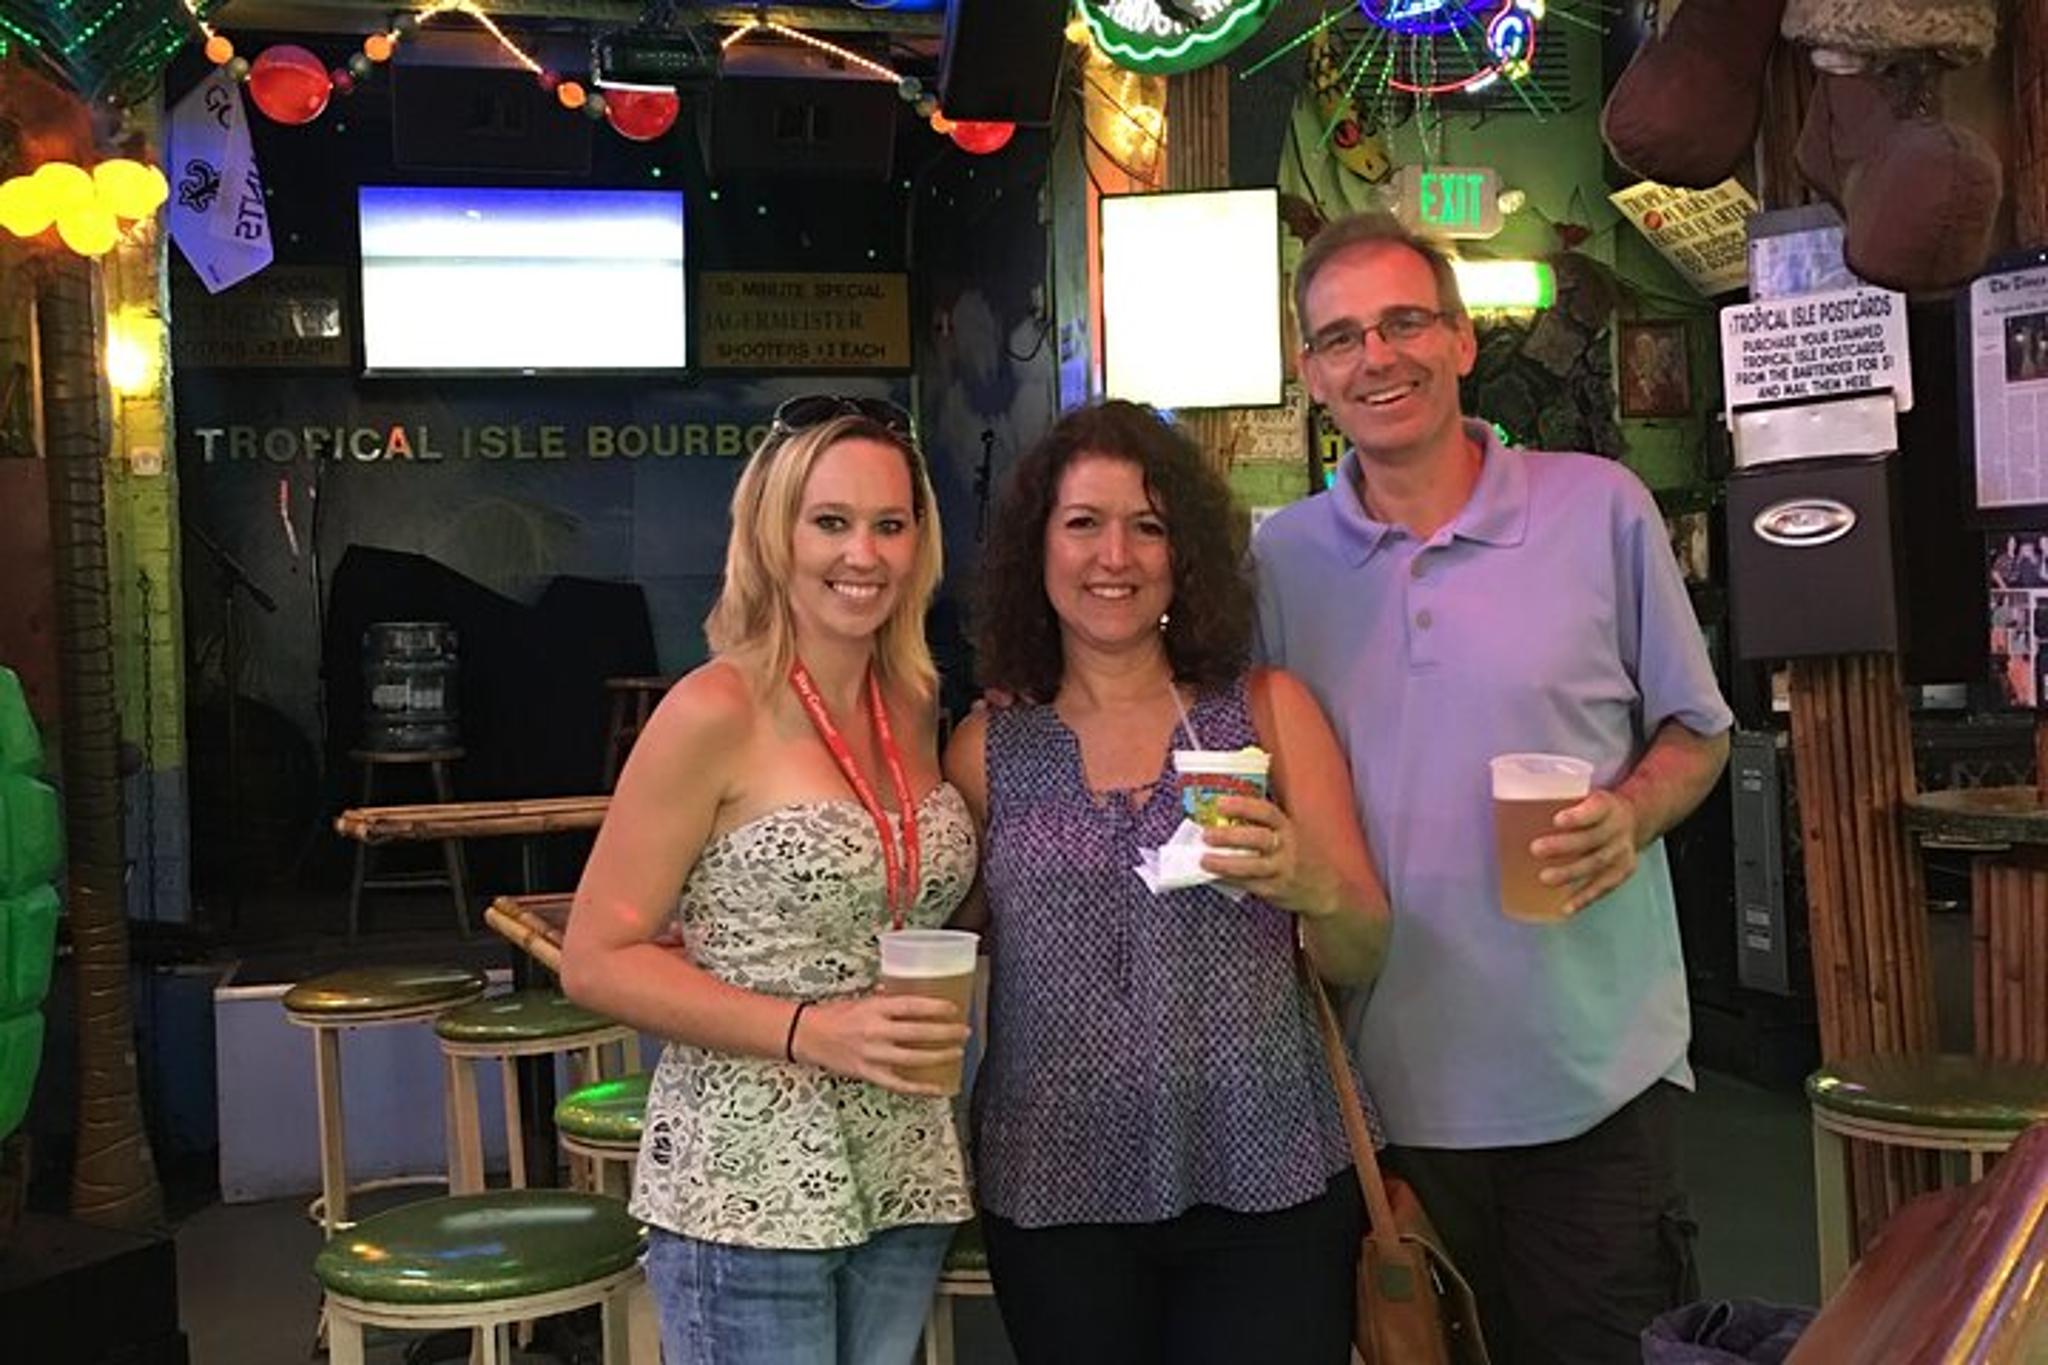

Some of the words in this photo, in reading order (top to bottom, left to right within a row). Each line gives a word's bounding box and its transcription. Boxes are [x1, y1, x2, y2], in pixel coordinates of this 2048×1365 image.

[1421, 170, 1483, 228] EXIT
[741, 281, 802, 297] MINUTE
[812, 281, 886, 298] SPECIAL
[1732, 308, 1788, 333] TROPICAL
[1791, 303, 1816, 327] ISLE
[1820, 295, 1892, 324] POSTCARDS
[716, 341, 809, 358] SHOOTERS
[840, 342, 886, 358] EACH
[1743, 335, 1797, 352] PURCHASE
[1800, 329, 1830, 346] YOUR
[1832, 325, 1884, 343] STAMPED
[1742, 352, 1793, 369] TROPICAL
[1795, 348, 1818, 362] ISLE
[1820, 341, 1886, 359] POSTCARDS
[1734, 370, 1766, 386] FROM
[1768, 367, 1789, 382] THE
[1792, 359, 1853, 379] BARTENDER
[1856, 356, 1878, 372] FOR
[1757, 383, 1782, 399] AND
[1783, 381, 1808, 397] MAIL
[1811, 377, 1841, 391] THEM
[1845, 372, 1873, 388] HERE
[194, 422, 443, 462] TROPICAL
[460, 424, 568, 460] ISLE
[587, 423, 772, 459] BOURBO
